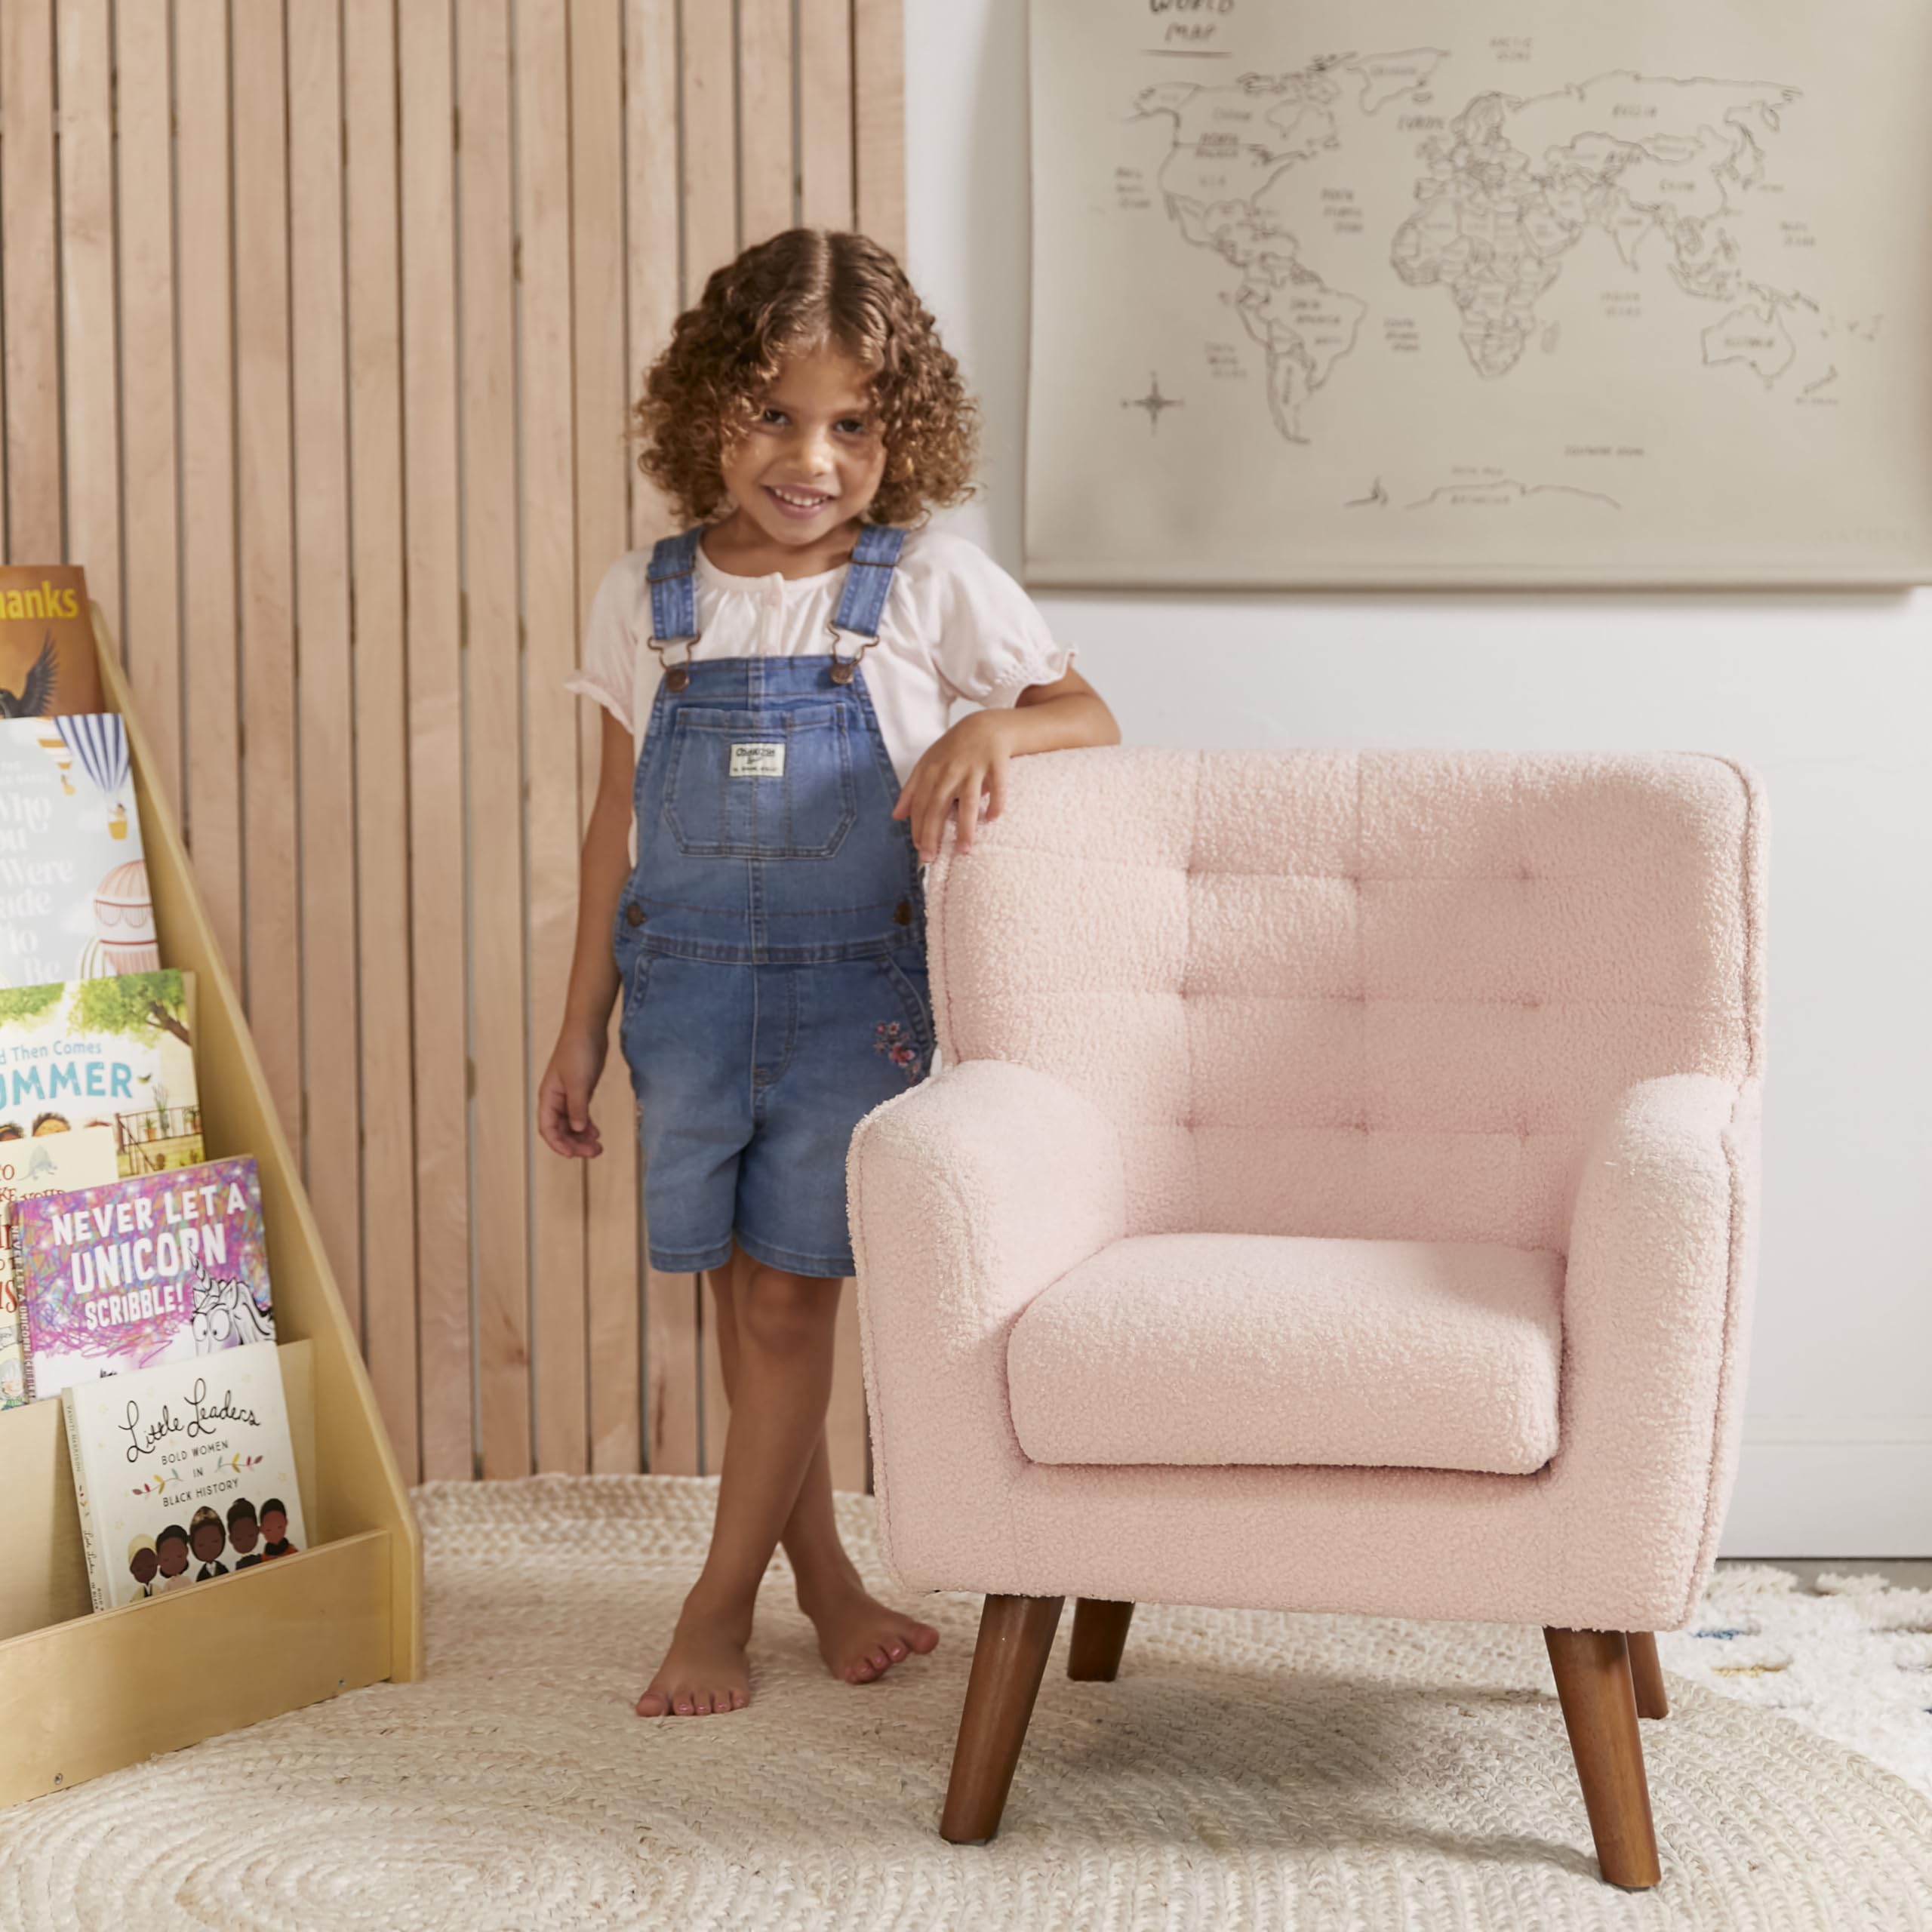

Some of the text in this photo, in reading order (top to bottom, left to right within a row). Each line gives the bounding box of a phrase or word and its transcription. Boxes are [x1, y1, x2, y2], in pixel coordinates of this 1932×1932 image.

[11, 1044, 48, 1062] Then
[53, 1040, 102, 1055] Comes
[51, 1197, 153, 1246] NEVER
[163, 1185, 218, 1225] LET
[226, 1183, 247, 1214] A
[71, 1223, 226, 1294] UNICORN
[85, 1283, 184, 1331] SCRIBBLE!
[118, 1378, 260, 1463] Little Leaders
[162, 1440, 229, 1466] BOLD WOMEN
[193, 1467, 204, 1478] IN
[162, 1478, 239, 1507] BLACK HISTORY
